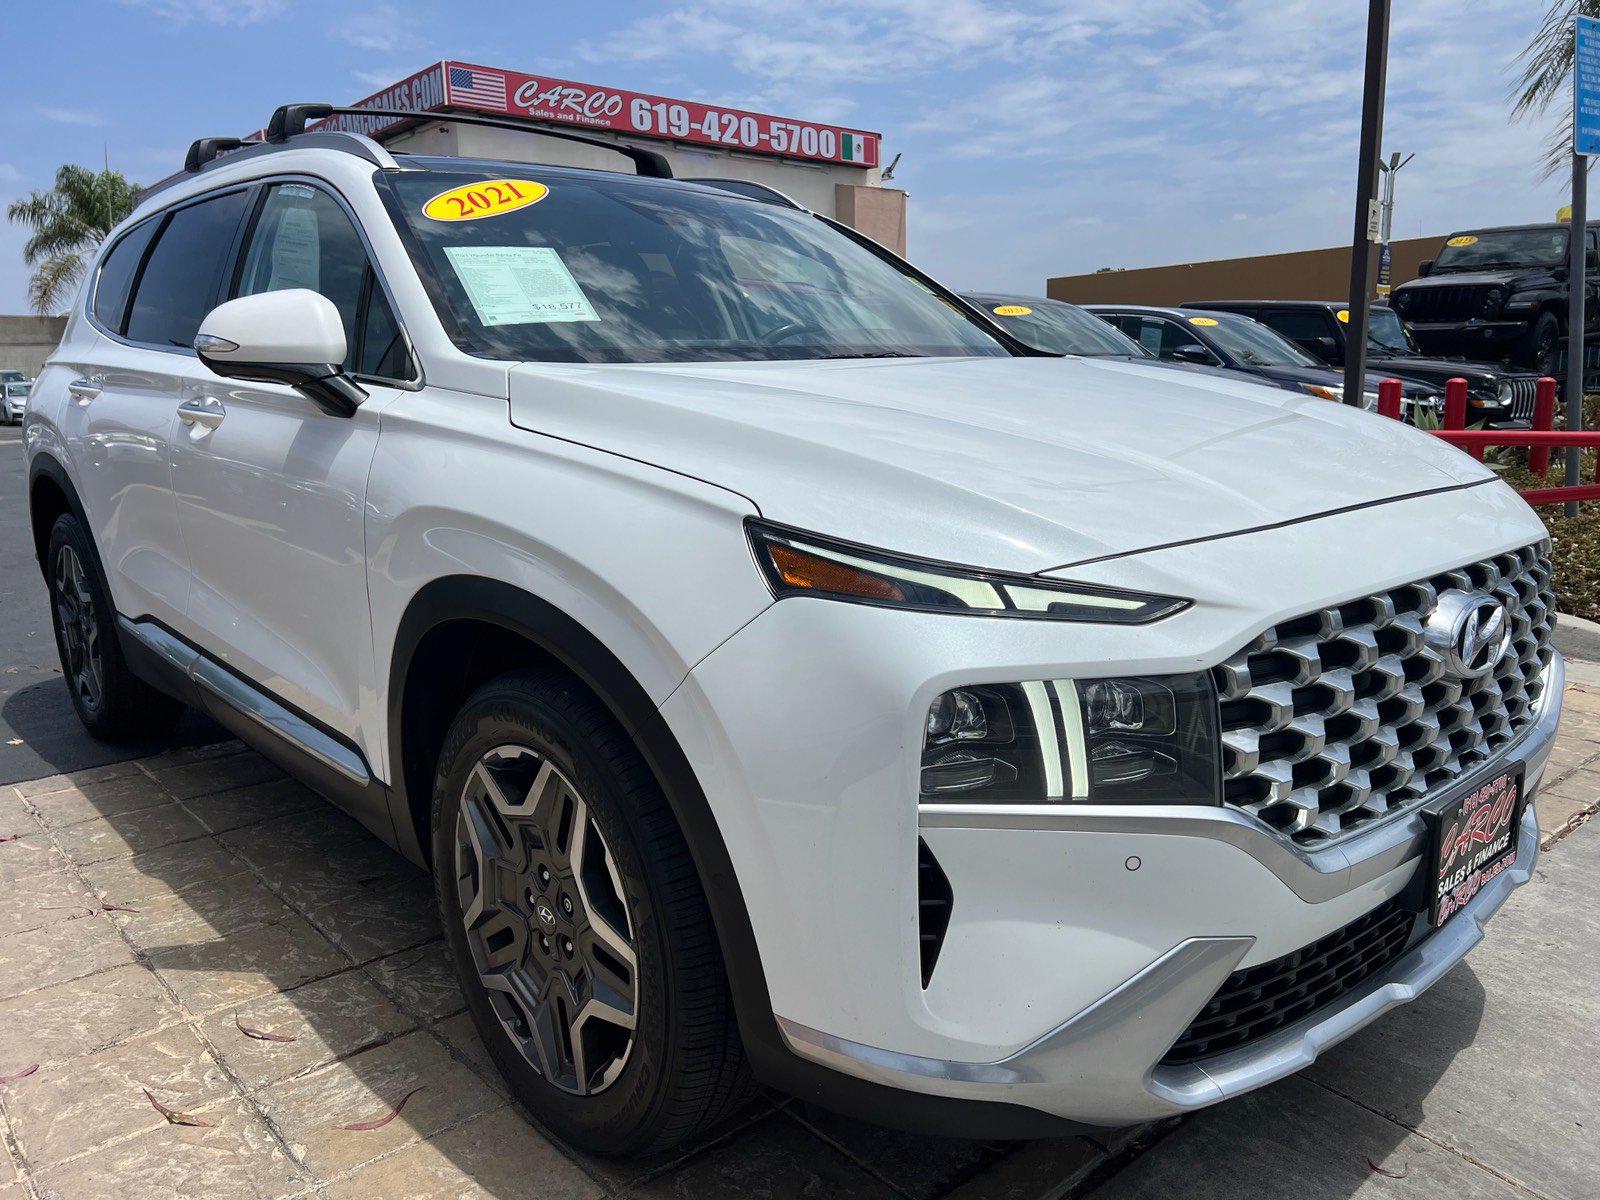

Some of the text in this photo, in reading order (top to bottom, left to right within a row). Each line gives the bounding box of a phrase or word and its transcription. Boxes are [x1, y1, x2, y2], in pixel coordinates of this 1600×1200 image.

[514, 80, 623, 117] CARCO
[528, 107, 611, 126] Sales and Finance
[630, 98, 836, 159] 619-420-5700
[446, 182, 529, 217] 2021
[532, 302, 582, 311] $18,577
[1439, 784, 1517, 880] CARCO
[1437, 832, 1511, 899] SALES & FINANCE
